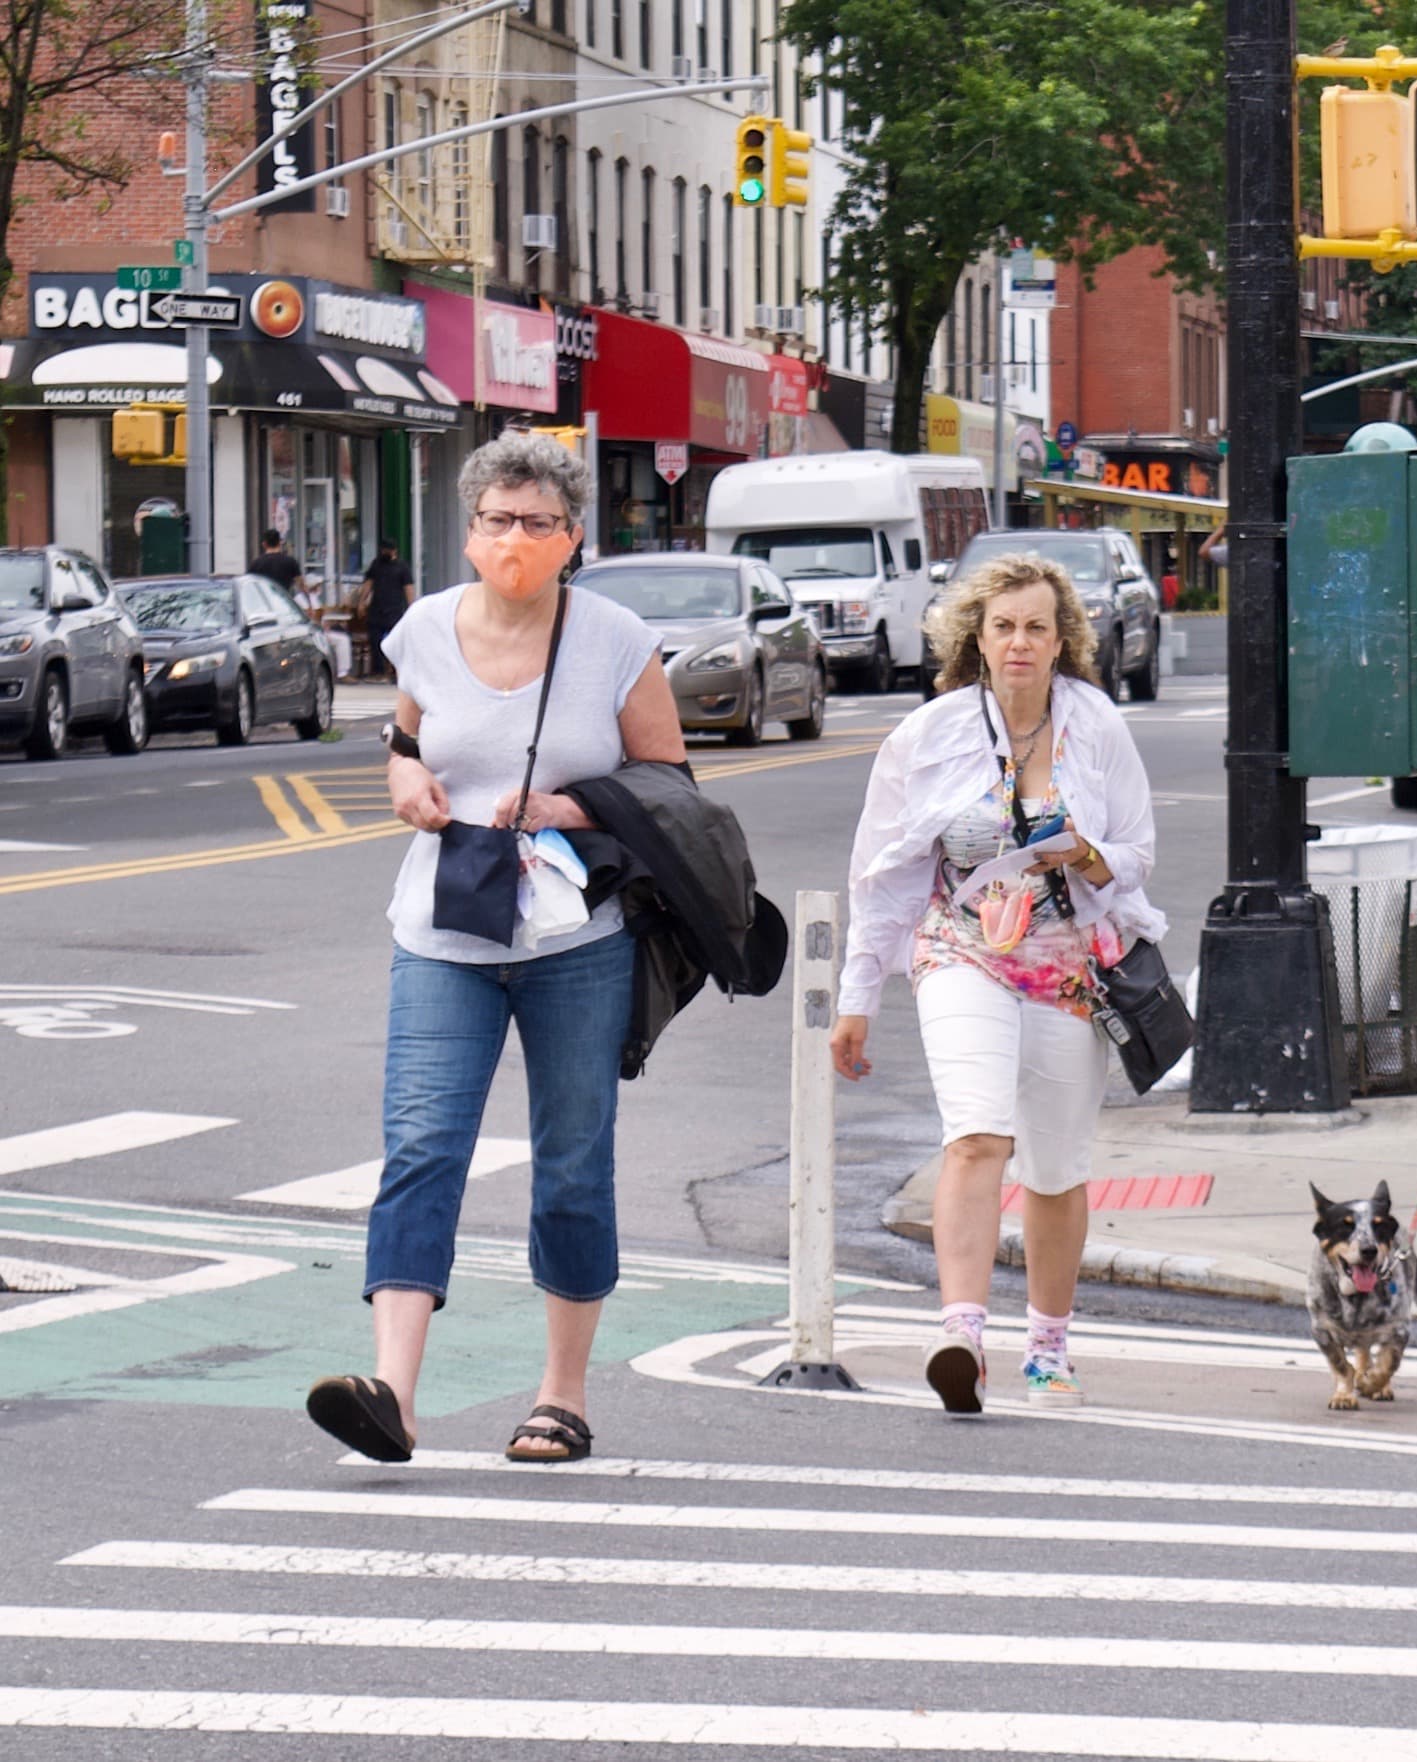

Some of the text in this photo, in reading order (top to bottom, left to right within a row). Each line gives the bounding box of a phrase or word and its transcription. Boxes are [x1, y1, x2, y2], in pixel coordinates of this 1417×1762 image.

[132, 269, 152, 288] 10
[161, 302, 229, 317] ONE WAY
[44, 388, 187, 403] HAND ROLLED BAGE
[932, 419, 956, 437] FOOD
[1103, 463, 1171, 491] BAR
